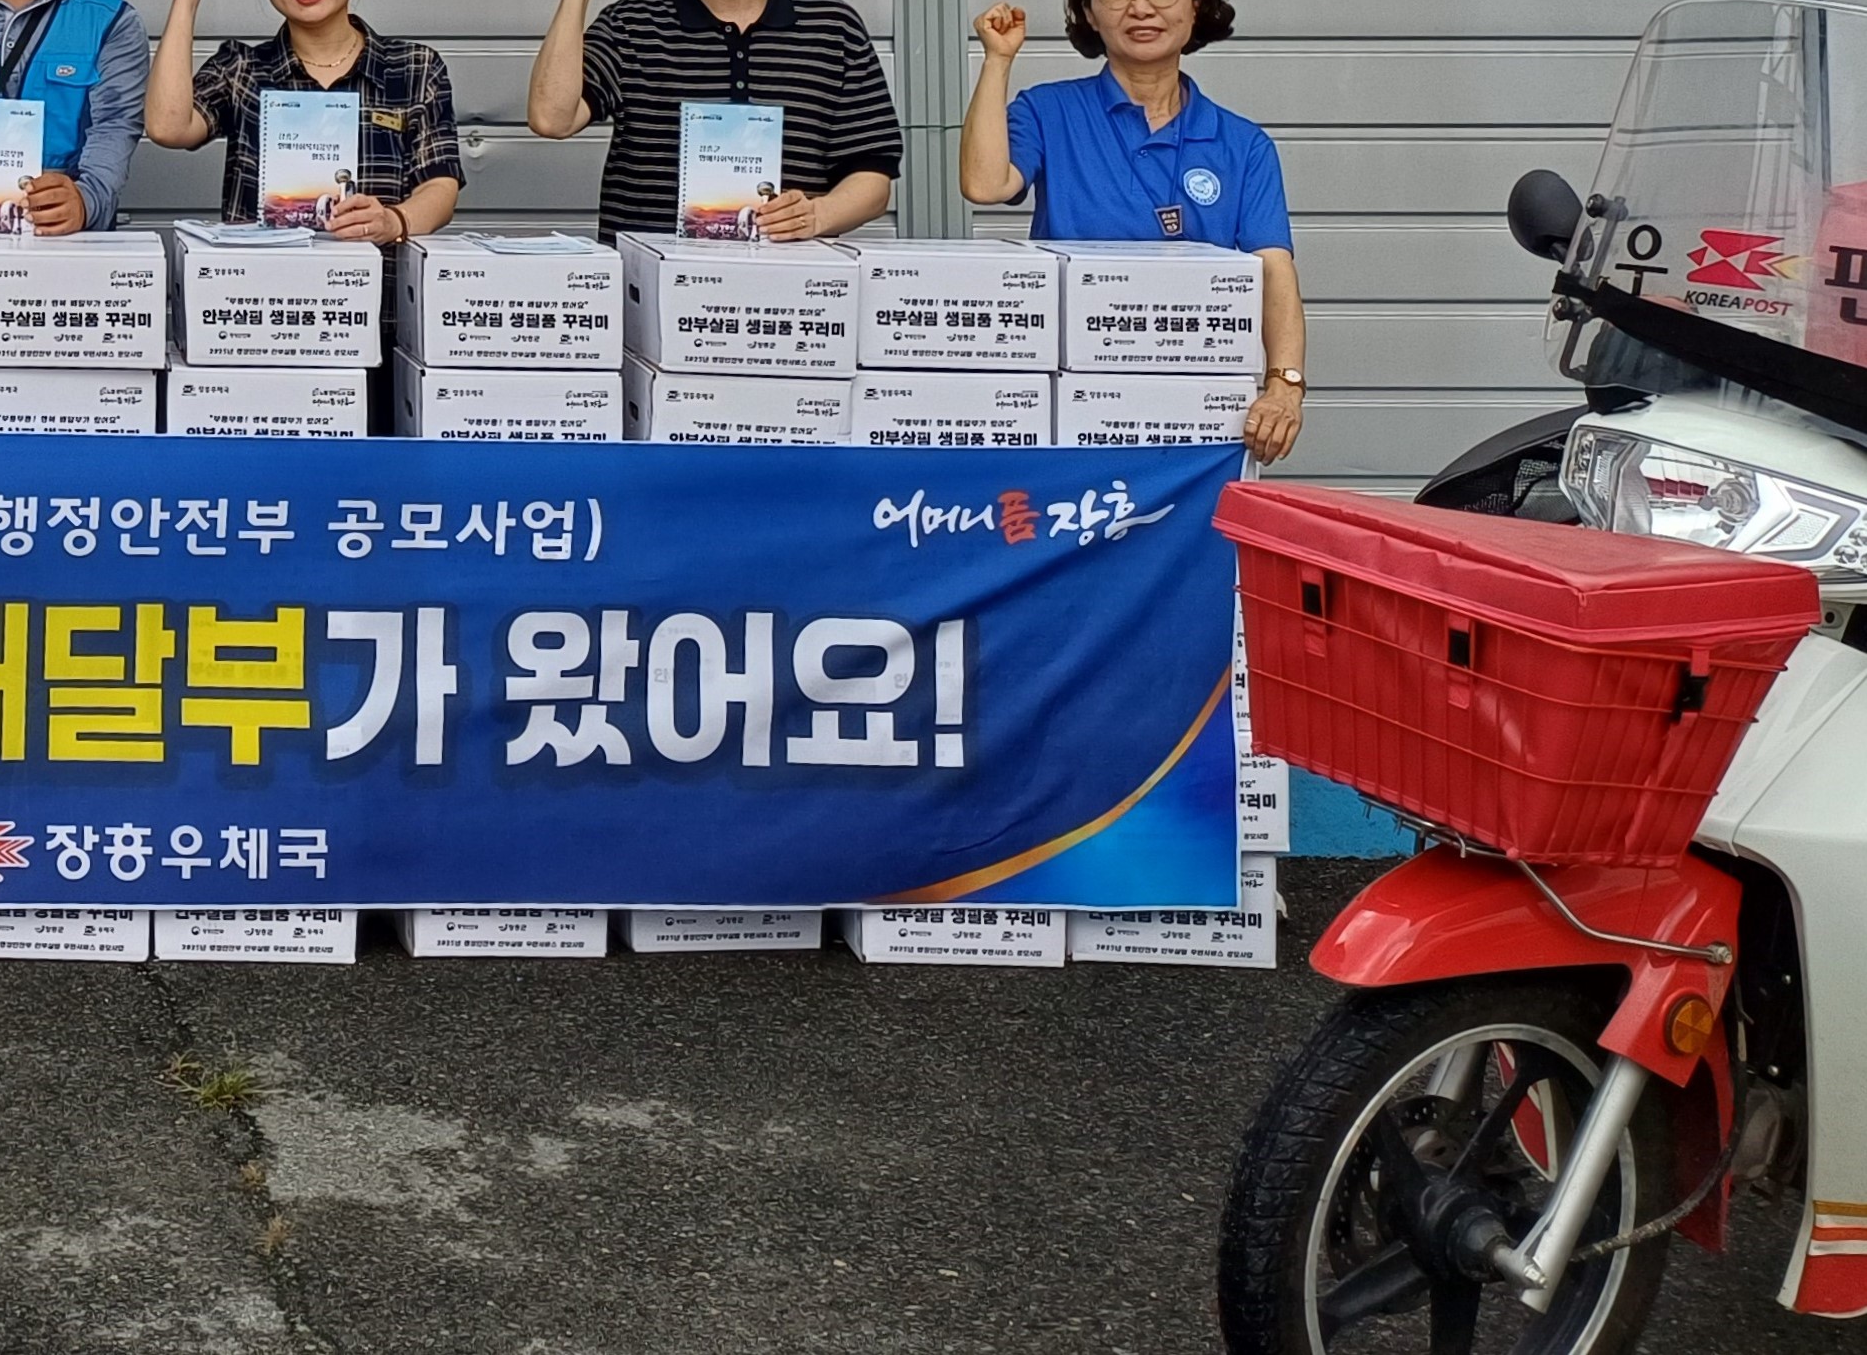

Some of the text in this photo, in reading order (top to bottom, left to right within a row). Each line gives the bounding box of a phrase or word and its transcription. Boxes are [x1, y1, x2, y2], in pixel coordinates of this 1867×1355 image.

[1615, 224, 1669, 296] 우
[52, 311, 99, 328] 생필품
[105, 312, 152, 328] 꾸러미
[202, 308, 368, 327] 안부살핌 생필품 꾸러미
[441, 310, 609, 330] 안부살핌 생필품 꾸러미
[677, 316, 845, 338] 안부살핌 생필품 꾸러미
[875, 309, 1045, 330] 안부살핌 생필품 꾸러미
[1086, 315, 1252, 334] 안부살핌 생필품 꾸러미
[1046, 479, 1176, 546] 장흥
[327, 496, 603, 562] 공모사업)
[505, 609, 966, 769] 왔어요!
[44, 823, 330, 882] 장흥우체국
